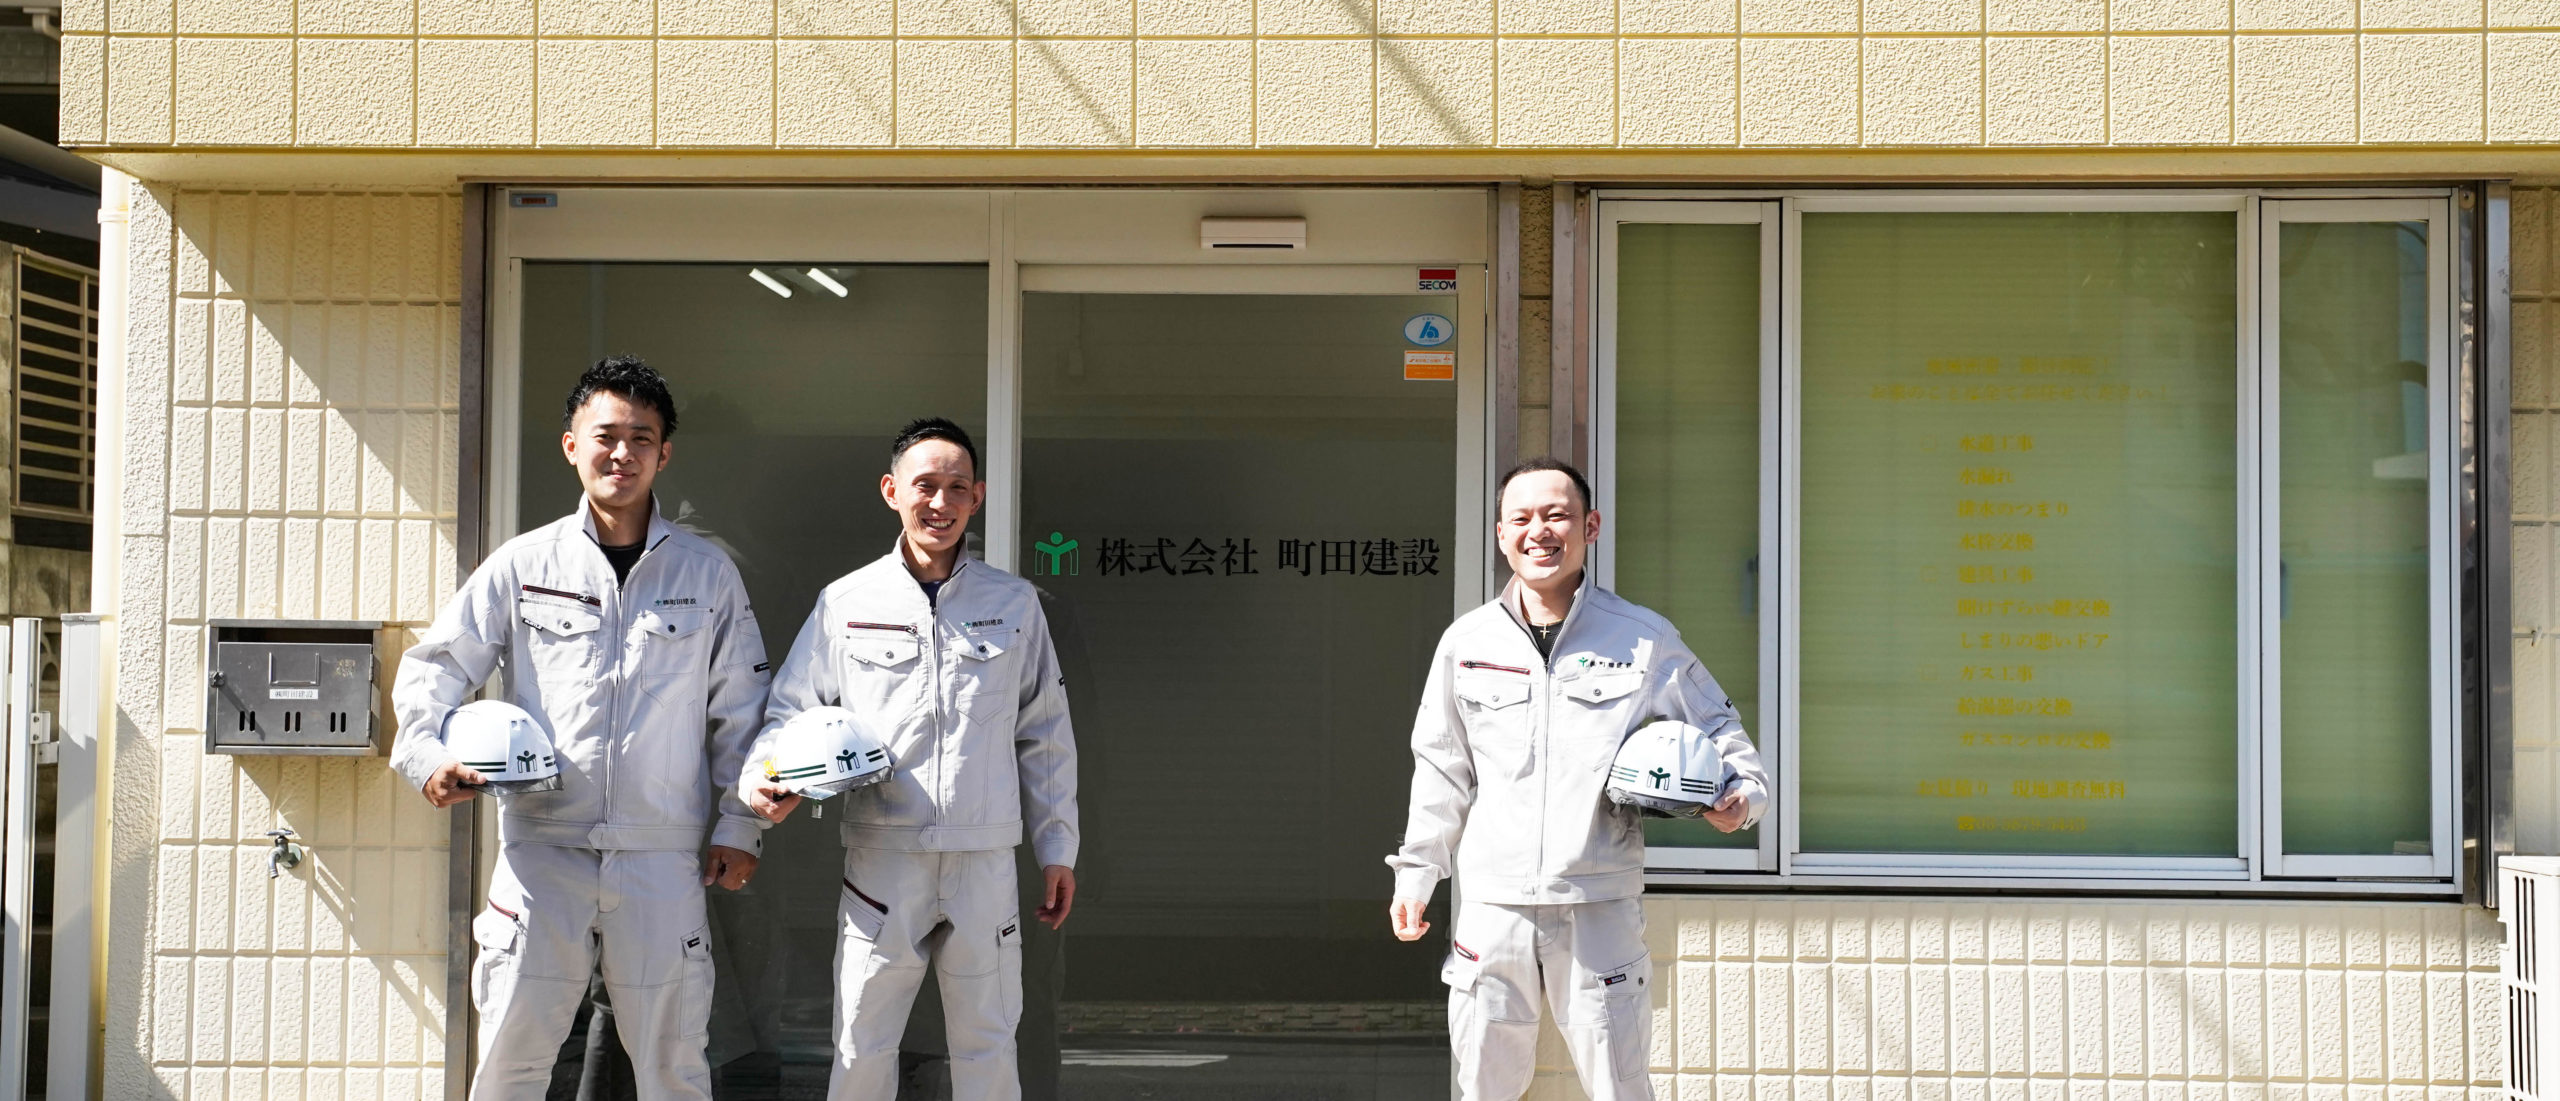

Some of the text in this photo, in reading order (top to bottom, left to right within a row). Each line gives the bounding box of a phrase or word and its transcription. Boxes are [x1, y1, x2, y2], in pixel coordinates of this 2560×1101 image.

[1419, 280, 1456, 290] SECOM
[1959, 434, 2034, 452] 水道工事
[1959, 467, 2014, 485] 水漏れ
[1957, 500, 2069, 518] 排水のつまり
[1959, 533, 2034, 551] 水栓交換
[1096, 537, 1440, 578] 株式会社 町田建設
[1957, 566, 2034, 584] 建具工事
[1961, 633, 2109, 650] しまりの悪いドア
[1960, 665, 2033, 682] ガス工事
[1957, 698, 2073, 716] 給湯器の交換
[1960, 731, 2112, 750] ガスコンロの交換
[2011, 780, 2125, 798] 現地調査無料
